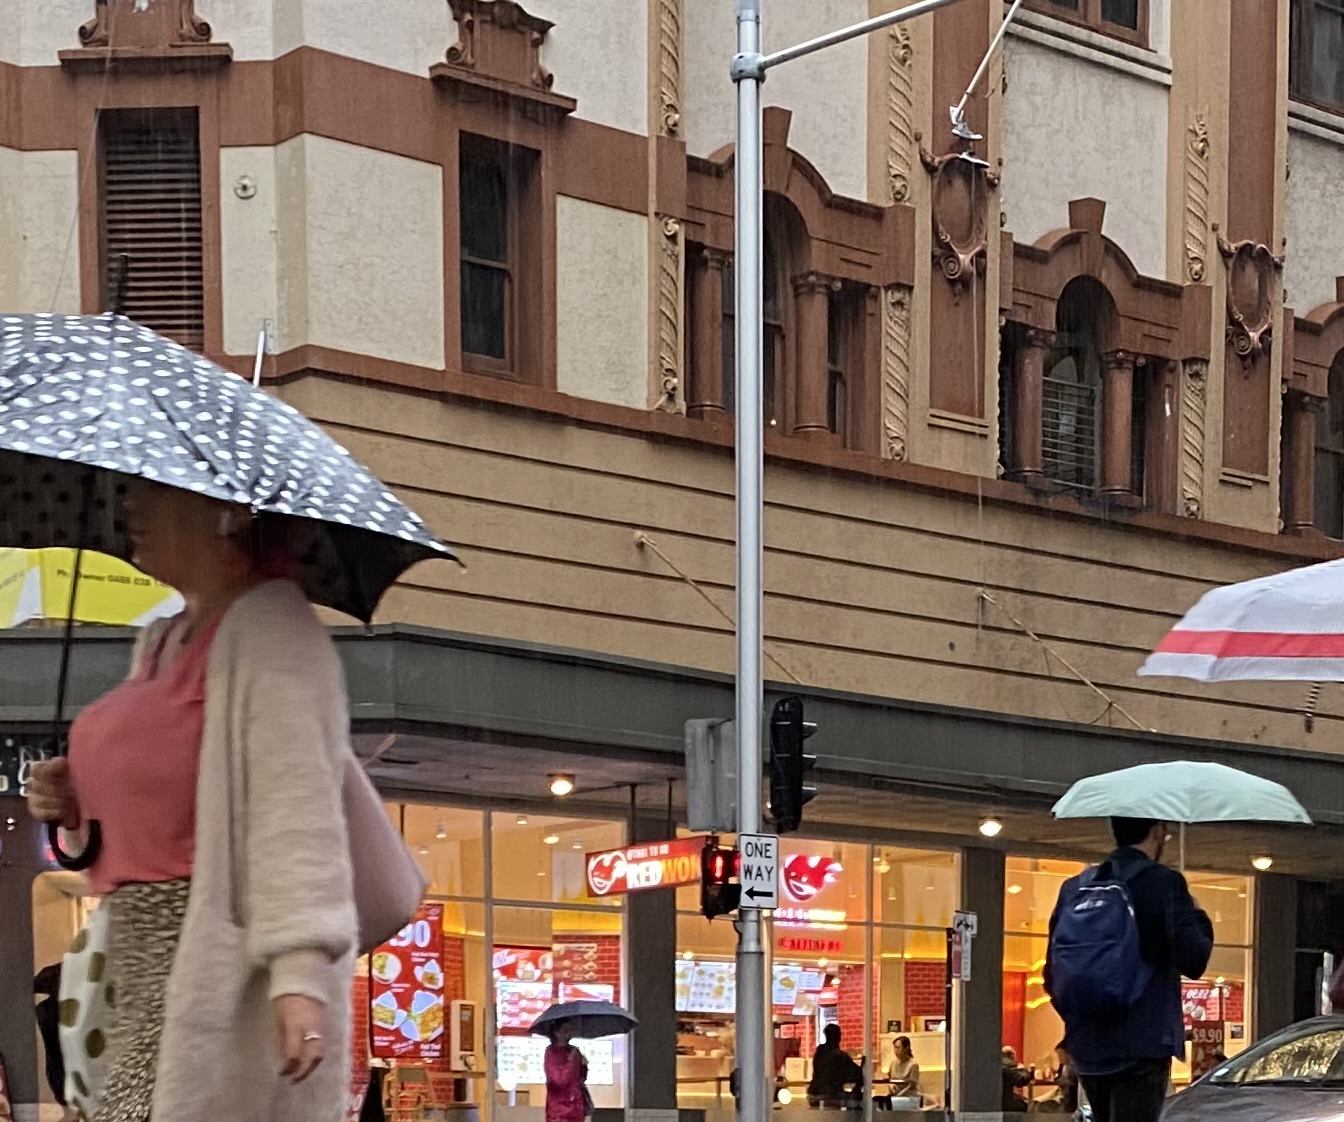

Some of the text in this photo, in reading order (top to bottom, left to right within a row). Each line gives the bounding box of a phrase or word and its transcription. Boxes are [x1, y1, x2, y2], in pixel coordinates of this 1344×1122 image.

[745, 843, 772, 858] ONE
[743, 865, 774, 881] WAY
[1192, 1028, 1223, 1043] $9.90
